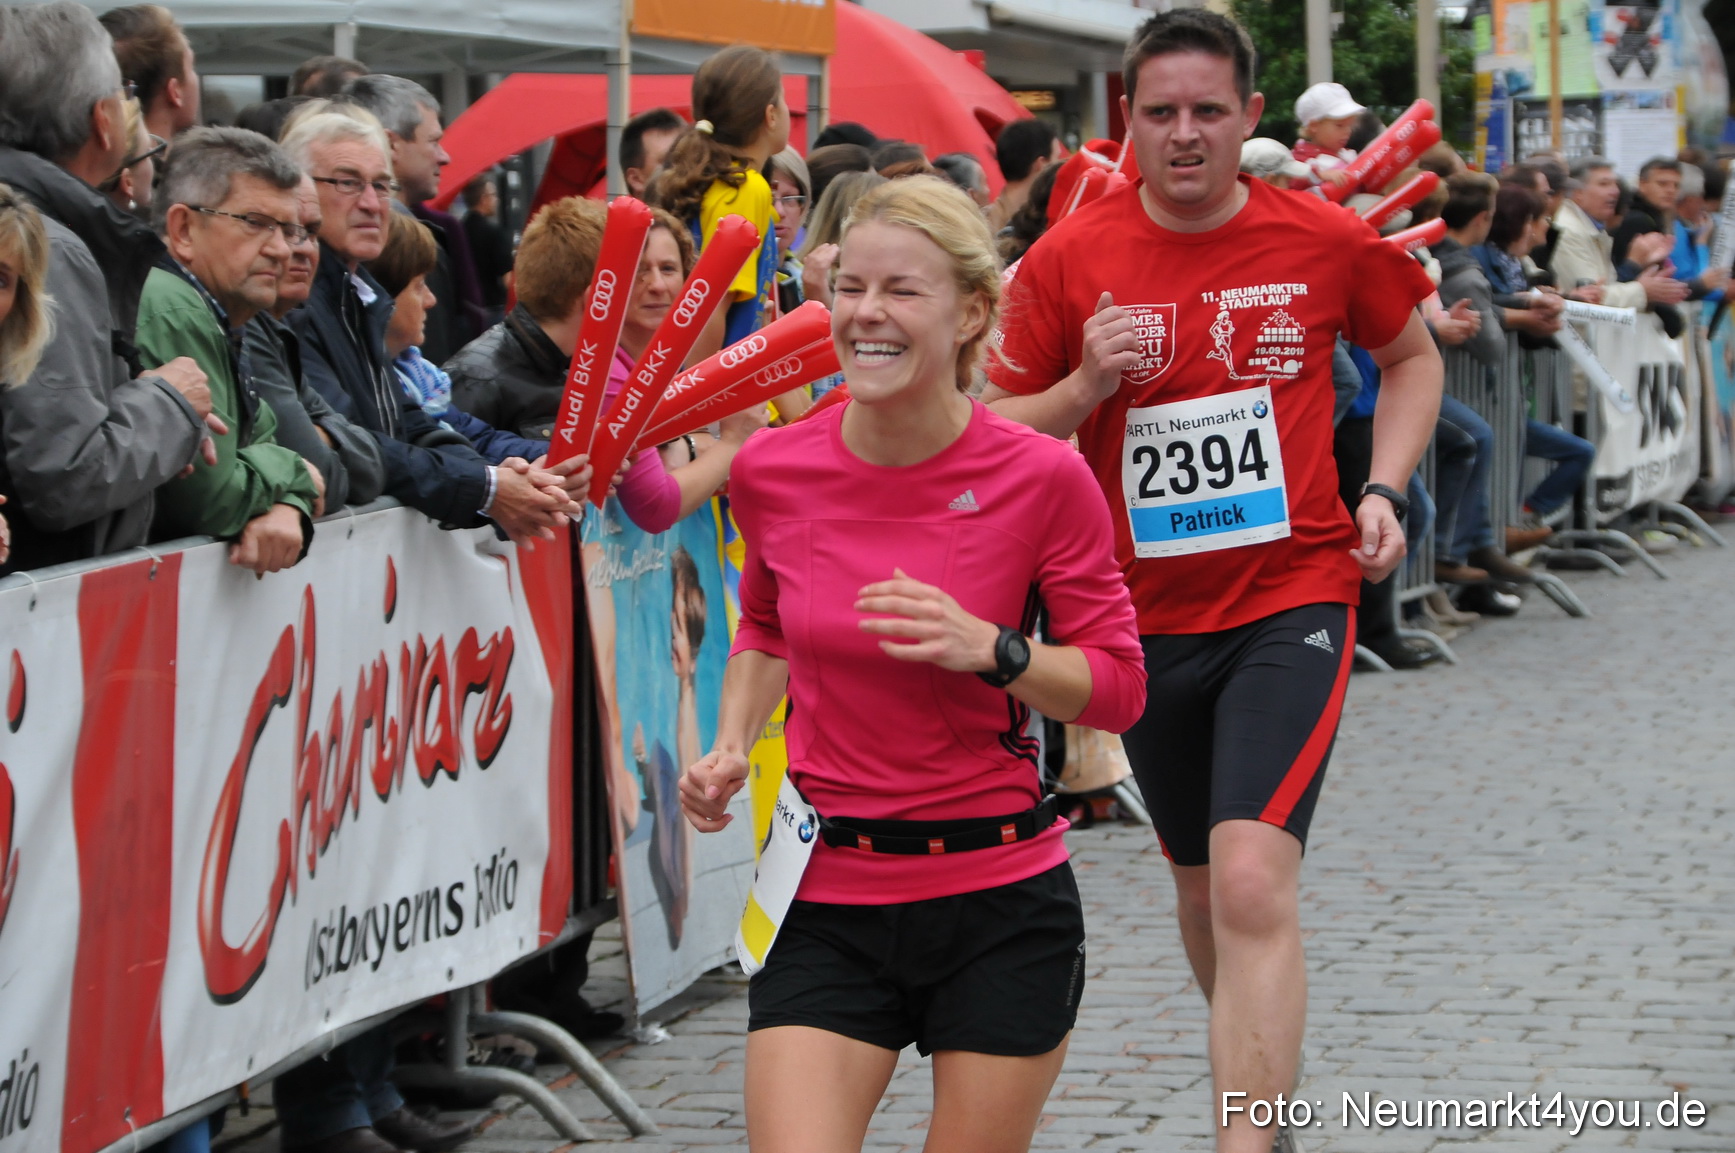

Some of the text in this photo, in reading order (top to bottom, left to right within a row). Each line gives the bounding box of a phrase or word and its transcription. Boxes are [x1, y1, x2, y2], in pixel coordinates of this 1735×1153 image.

[1201, 283, 1308, 304] 11. NEUMARKTER
[1219, 294, 1292, 311] STADTLAUF
[1254, 346, 1305, 356] 19.09.2010
[559, 339, 598, 444] Audi BKK
[607, 340, 672, 440] Audi BKK
[663, 368, 705, 401] BKK
[1169, 408, 1247, 433] Neumarkt
[1132, 427, 1268, 500] 2394
[1170, 503, 1246, 534] Patrick
